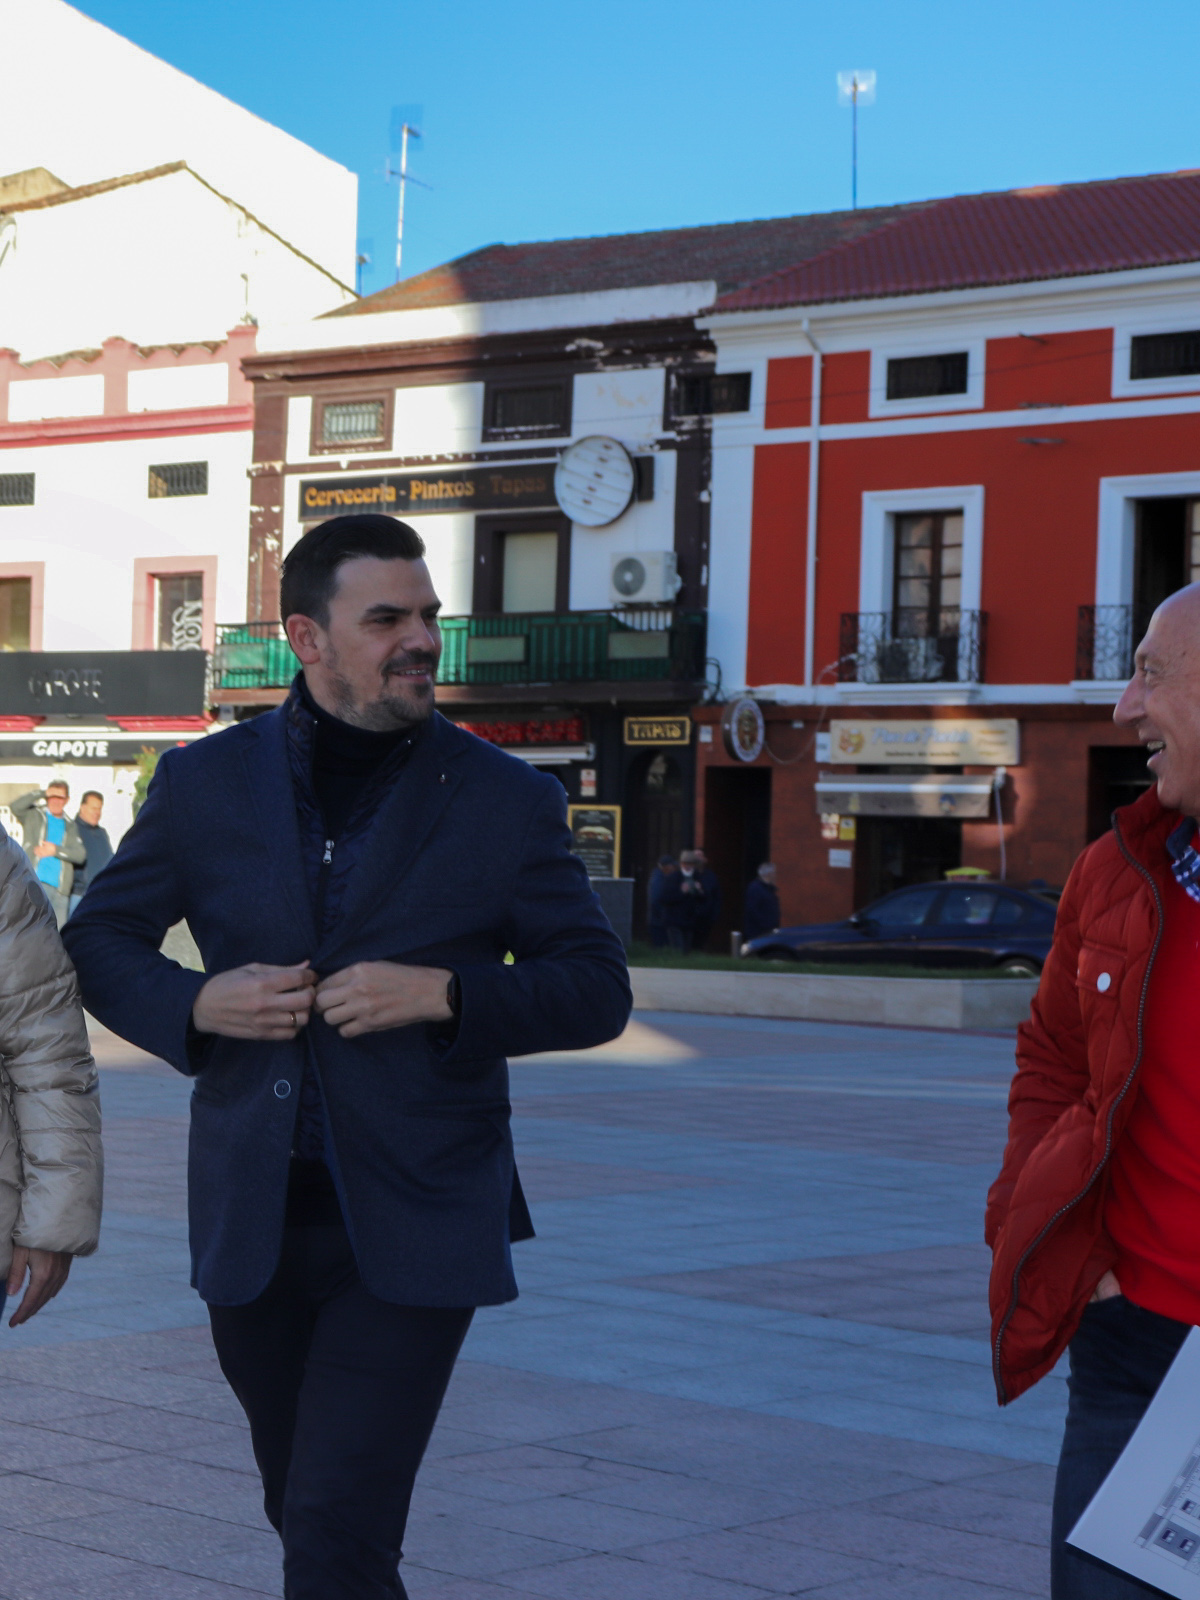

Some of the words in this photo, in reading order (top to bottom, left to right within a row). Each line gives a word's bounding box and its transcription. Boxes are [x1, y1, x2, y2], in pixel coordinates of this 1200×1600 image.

[410, 479, 475, 501] Pintxos
[489, 475, 547, 497] Tapas
[631, 723, 682, 739] TAPAS
[32, 740, 109, 757] CAPOTE
